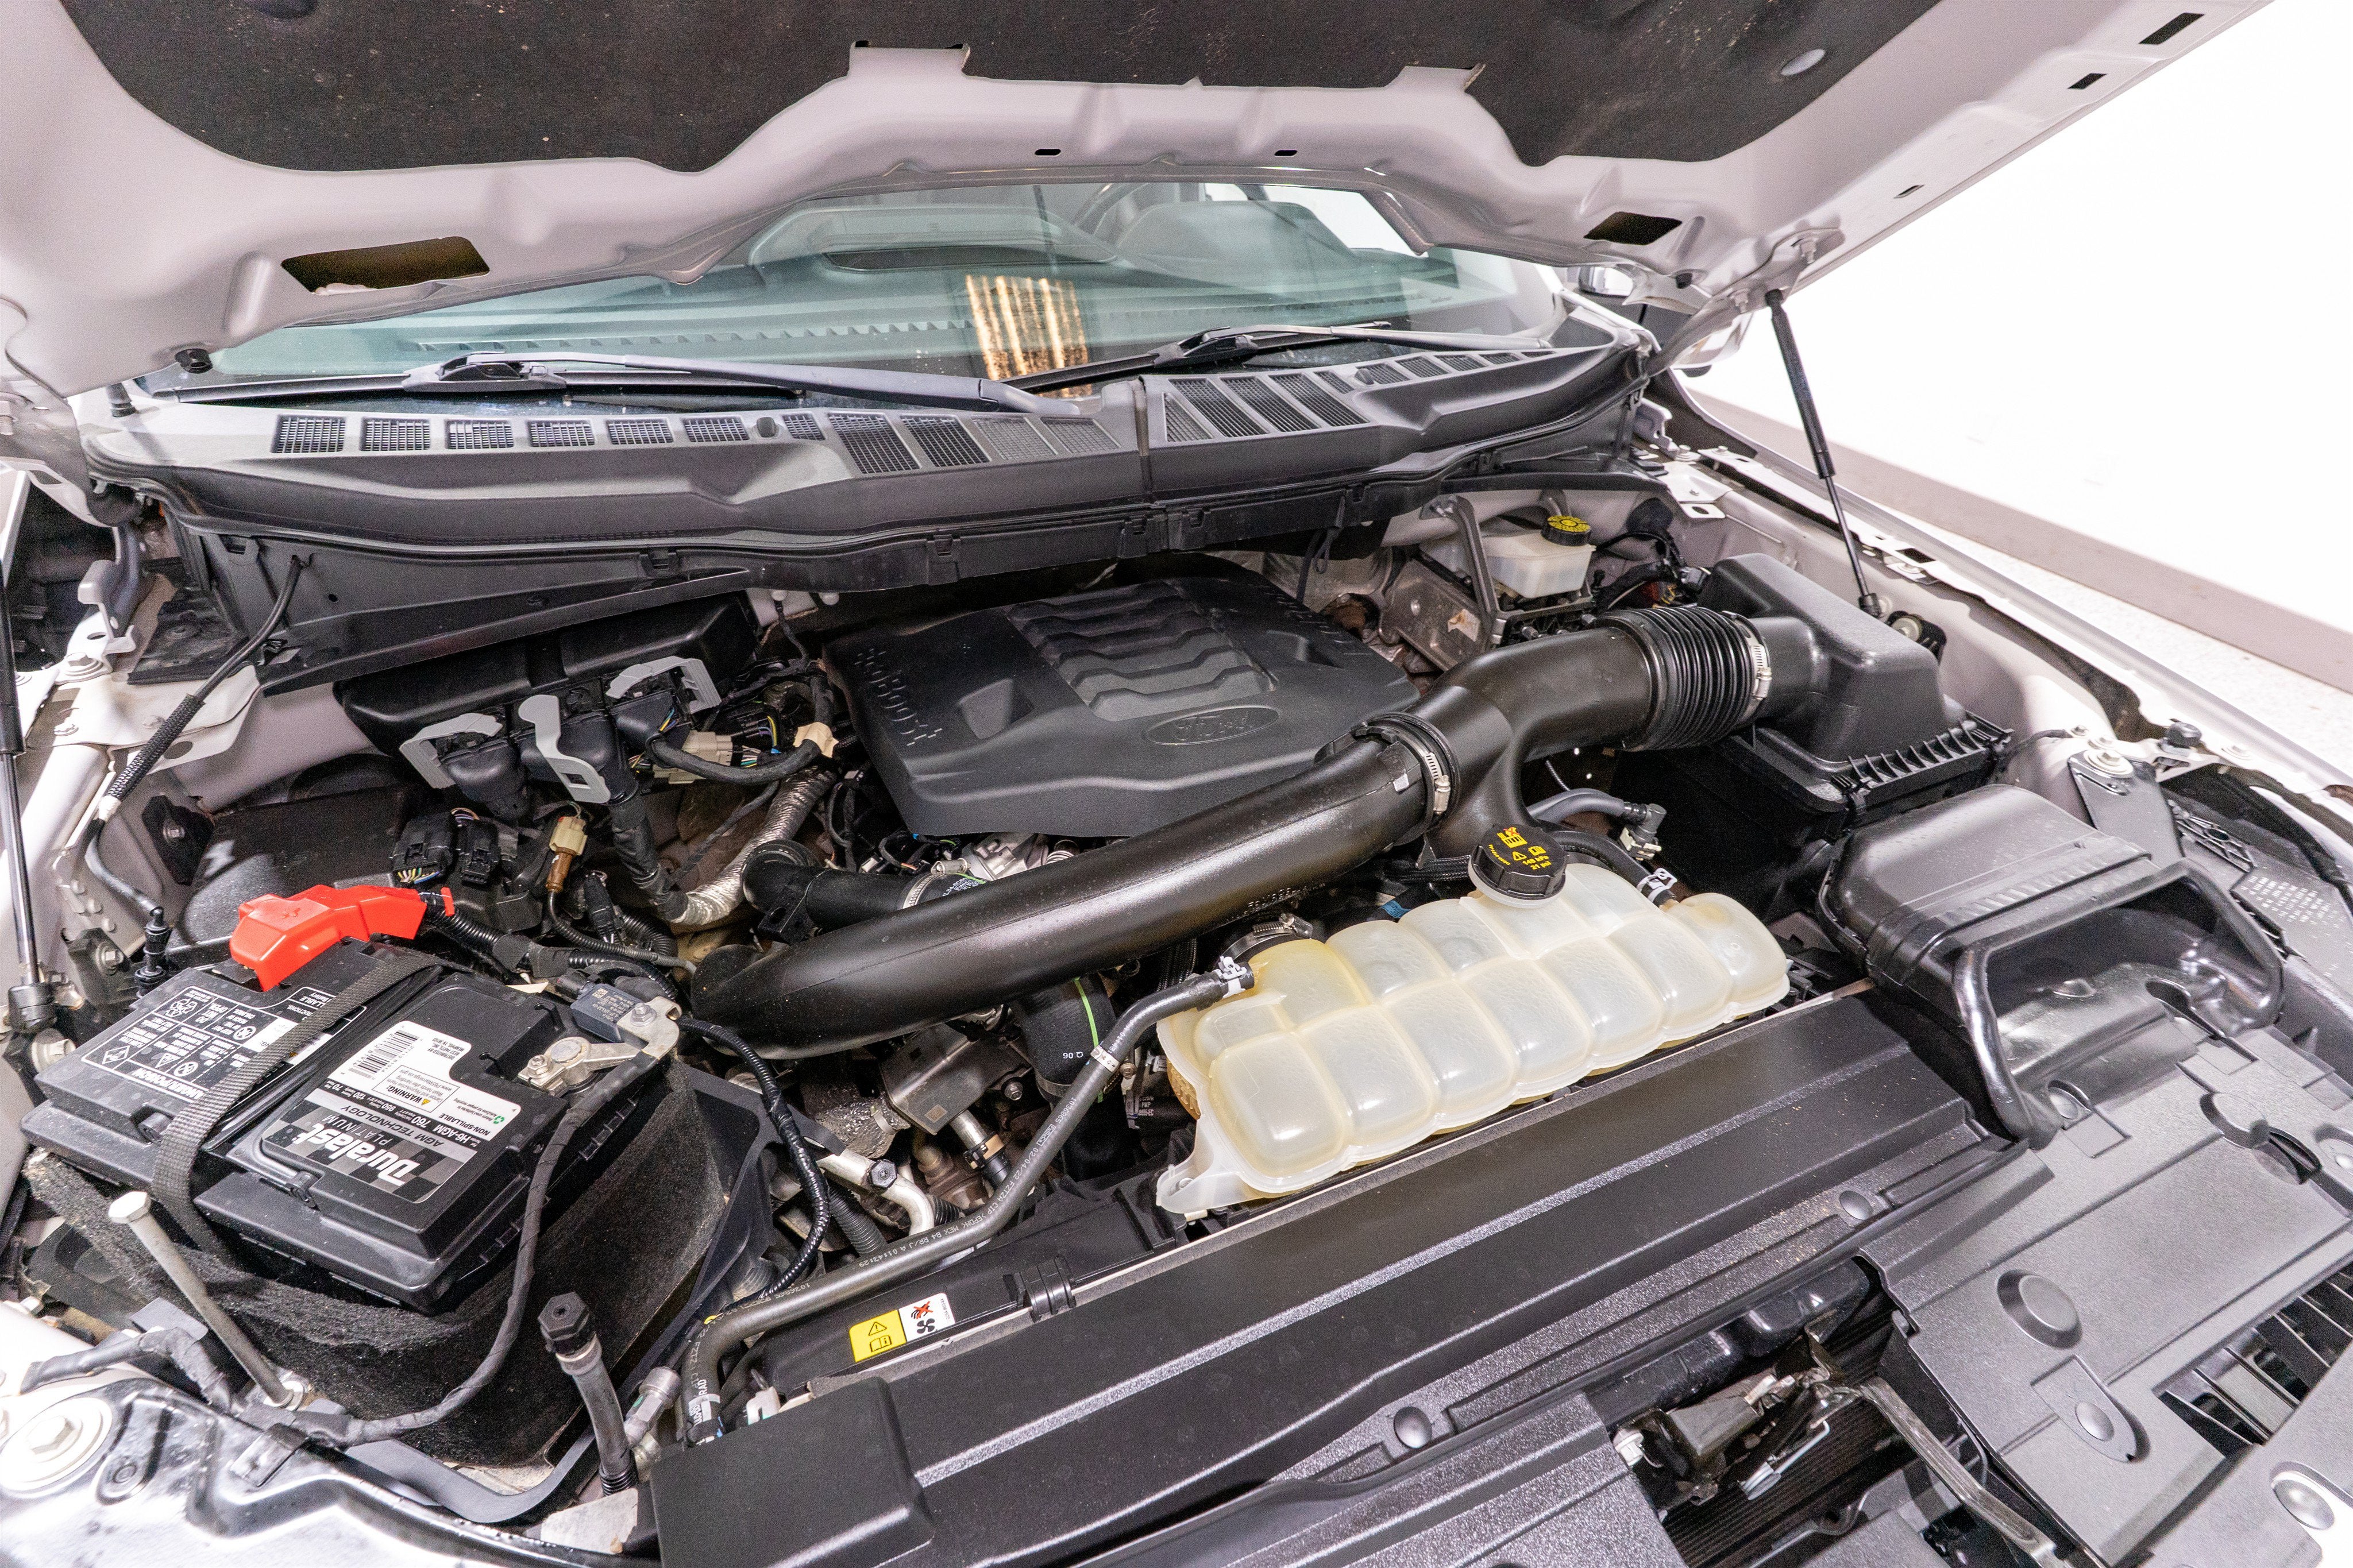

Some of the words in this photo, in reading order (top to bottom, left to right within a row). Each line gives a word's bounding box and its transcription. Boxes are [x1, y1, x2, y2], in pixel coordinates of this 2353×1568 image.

[1174, 710, 1256, 741] Ford
[298, 996, 327, 1007] LLABLE
[307, 991, 331, 1002] Battery
[200, 1009, 219, 1018] NOT
[205, 1002, 229, 1013] OPEN.
[284, 1004, 314, 1015] RUCTIONS.
[194, 1015, 210, 1024] DO
[231, 1016, 249, 1024] REACH
[130, 1067, 206, 1100] ANGER/POISON
[398, 1068, 454, 1091] www.P65Warnings.ca.gov
[384, 1085, 423, 1103] WARNING:
[396, 1082, 423, 1094] Reproductive
[352, 1091, 367, 1100] 120
[427, 1094, 443, 1102] Cancer
[380, 1102, 396, 1111] 950
[1054, 1096, 1077, 1124] 1036865
[340, 1106, 415, 1136] TECHNOLOGY
[410, 1115, 432, 1127] 760
[438, 1113, 491, 1136] NON-SPILLABLE
[321, 1114, 394, 1145] PLATINUM
[432, 1123, 472, 1143] H6-AGM
[414, 1133, 445, 1146] AGM
[292, 1122, 421, 1185] Duralast
[1012, 1146, 1038, 1180] 02/04/22
[997, 1180, 1015, 1201] FZTZA
[986, 1202, 998, 1214] CIP
[931, 1231, 941, 1239] B4
[943, 1225, 959, 1235] MEX
[908, 1236, 928, 1248] RR/J
[858, 1248, 897, 1267] 01:43:29
[698, 1378, 707, 1395] RAD
